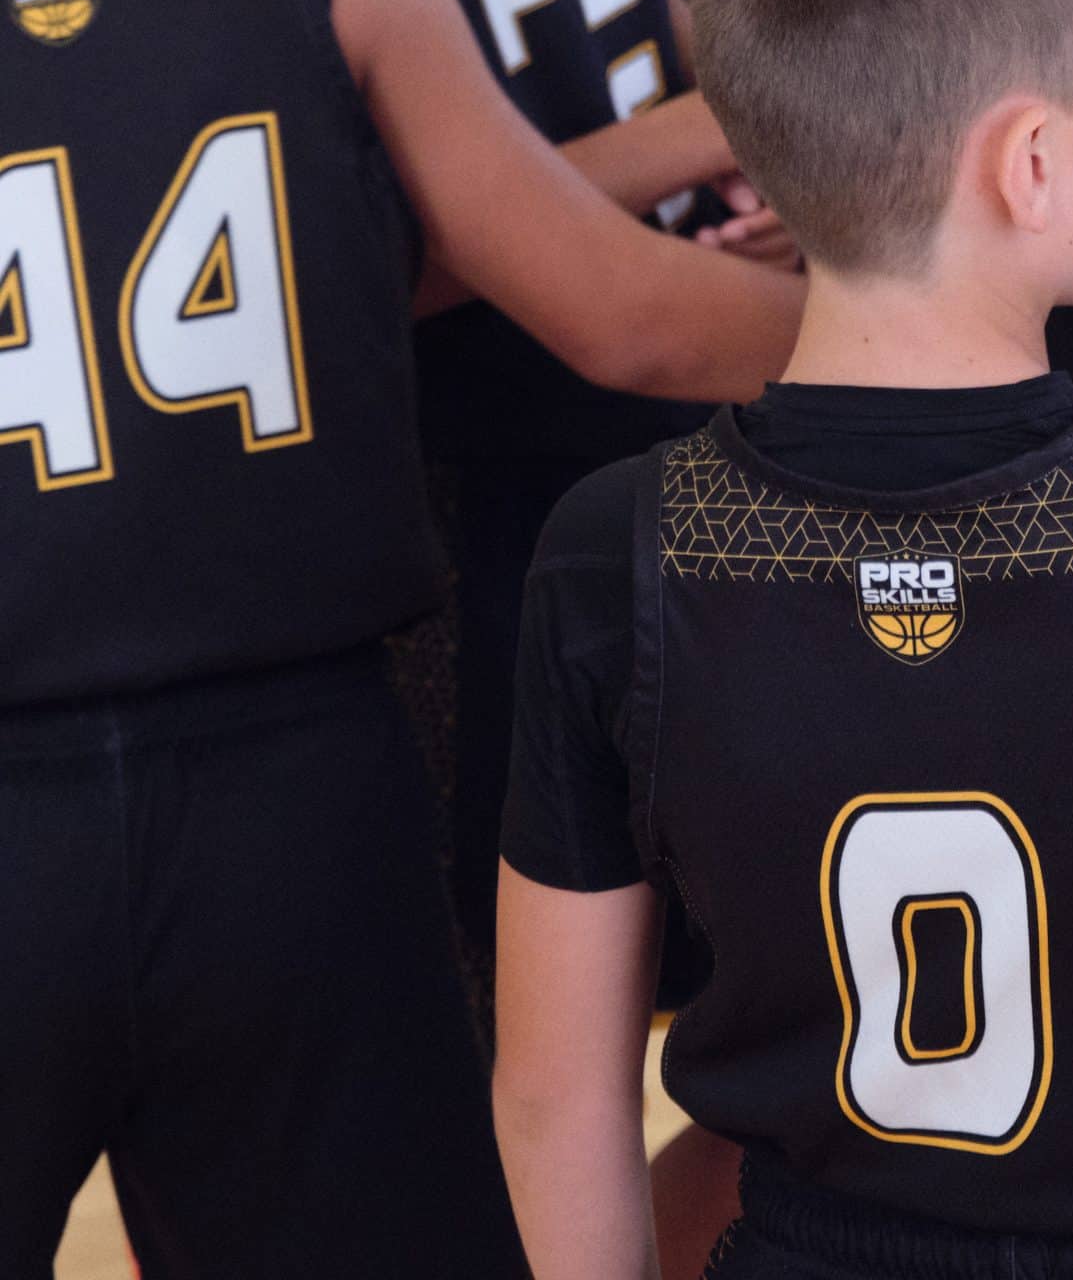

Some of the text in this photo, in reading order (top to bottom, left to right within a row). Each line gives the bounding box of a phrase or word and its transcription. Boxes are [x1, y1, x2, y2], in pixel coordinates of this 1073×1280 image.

[0, 111, 314, 492] 44
[859, 561, 955, 589] PRO
[861, 588, 957, 604] SKILLS
[863, 603, 959, 612] BASKETBALL
[820, 791, 1053, 1155] 0
